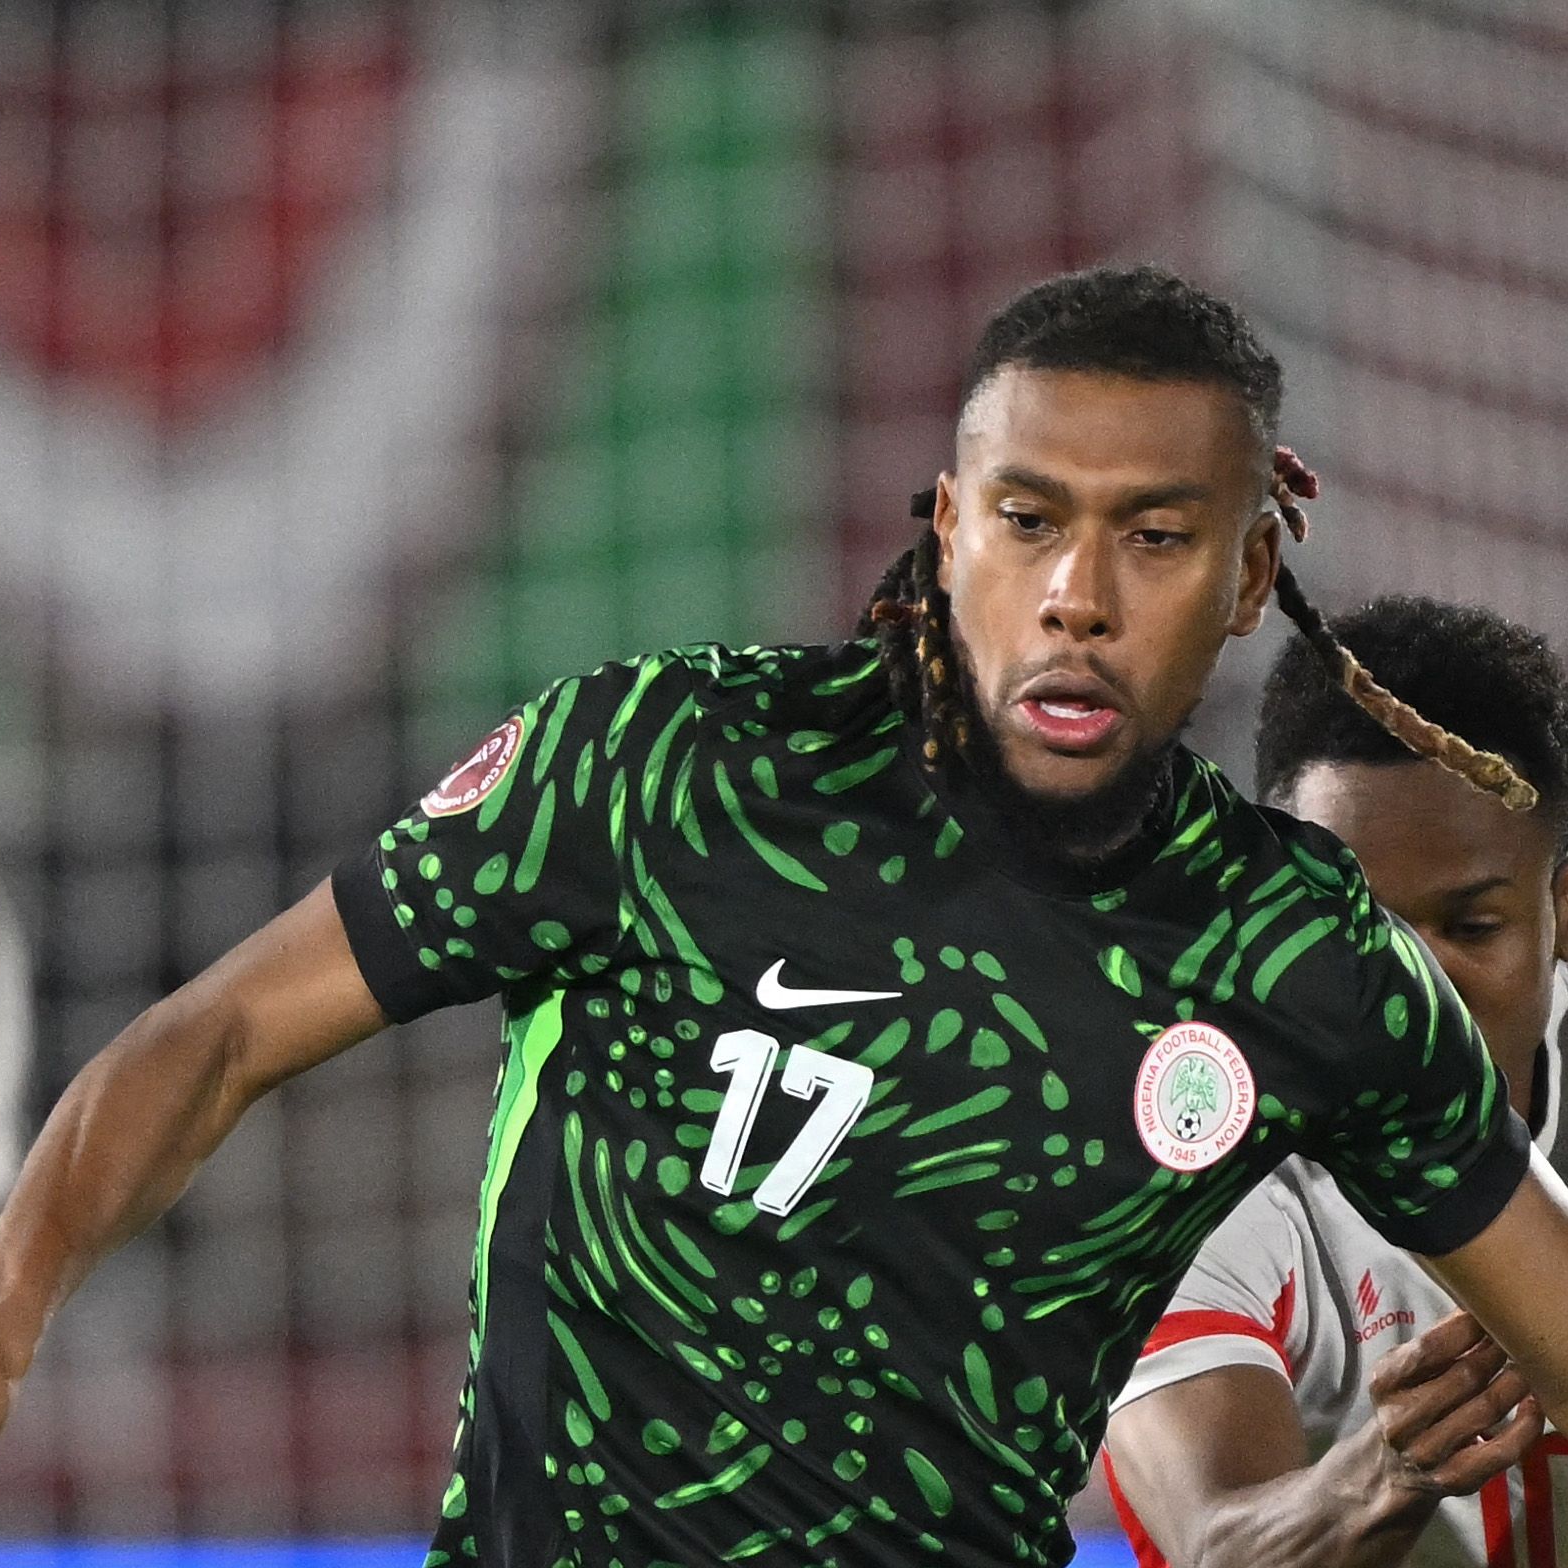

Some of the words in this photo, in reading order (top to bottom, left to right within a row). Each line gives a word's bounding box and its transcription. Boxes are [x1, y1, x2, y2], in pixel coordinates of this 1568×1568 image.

[480, 767, 500, 791] CUP
[699, 1028, 875, 1217] 17
[1141, 1065, 1160, 1133] NIGERIA
[1155, 1029, 1221, 1063] FOOTBALL
[1215, 1047, 1249, 1151] FEDERATION
[1168, 1145, 1196, 1162] 1945
